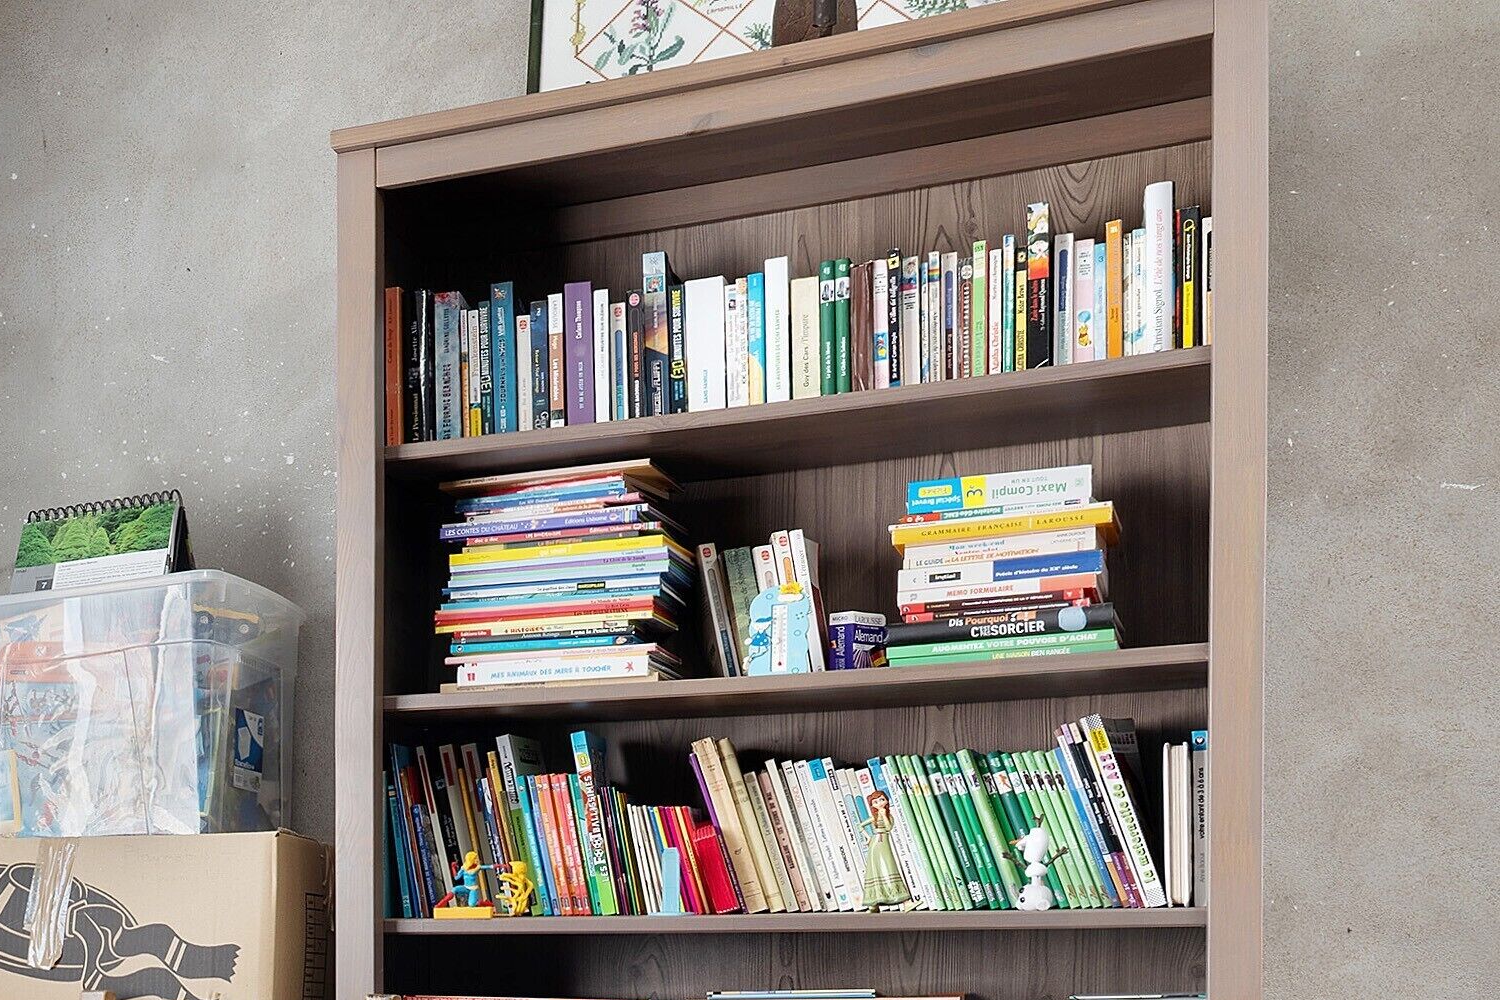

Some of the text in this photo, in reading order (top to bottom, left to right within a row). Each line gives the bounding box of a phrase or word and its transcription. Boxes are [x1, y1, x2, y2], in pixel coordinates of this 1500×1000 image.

[1152, 209, 1165, 352] Christian Signol L'été de nos vingt ans
[671, 290, 682, 317] SURVIVRE
[1016, 284, 1025, 315] Mister Brown
[479, 307, 489, 334] SURVIVRE
[672, 317, 682, 333] POUR
[480, 334, 489, 349] POUR
[991, 321, 999, 347] Christie
[470, 326, 479, 377] Frankenstein
[673, 333, 683, 360] MINUTES
[480, 349, 489, 375] MINUTES
[802, 375, 811, 388] Guy
[912, 495, 961, 506] Spécial Brevet
[992, 482, 1067, 499] Maxi Compil
[456, 527, 480, 536] CONTES
[491, 523, 519, 533] CHÂTEAU
[920, 514, 1084, 537] GRAMMAIRE FRANÇAISE LAROUSSE
[41, 581, 48, 589] 7
[948, 613, 1009, 628] Dis Pourquoi
[990, 620, 1046, 637] SORCIER
[833, 626, 846, 657] Allemand
[853, 629, 885, 643] Allemand
[931, 631, 1099, 654] AUGMENTEZ VOTRE POUVOIR D'ACHAT
[502, 761, 518, 804] MINECRAFT
[1110, 783, 1127, 798] de
[584, 775, 610, 882] LES FOOTBALLISSIMES
[1119, 801, 1150, 866] maternelle
[839, 845, 851, 872] HITCHCOCK
[1142, 870, 1156, 883] la
[967, 880, 984, 902] STAR WARS
